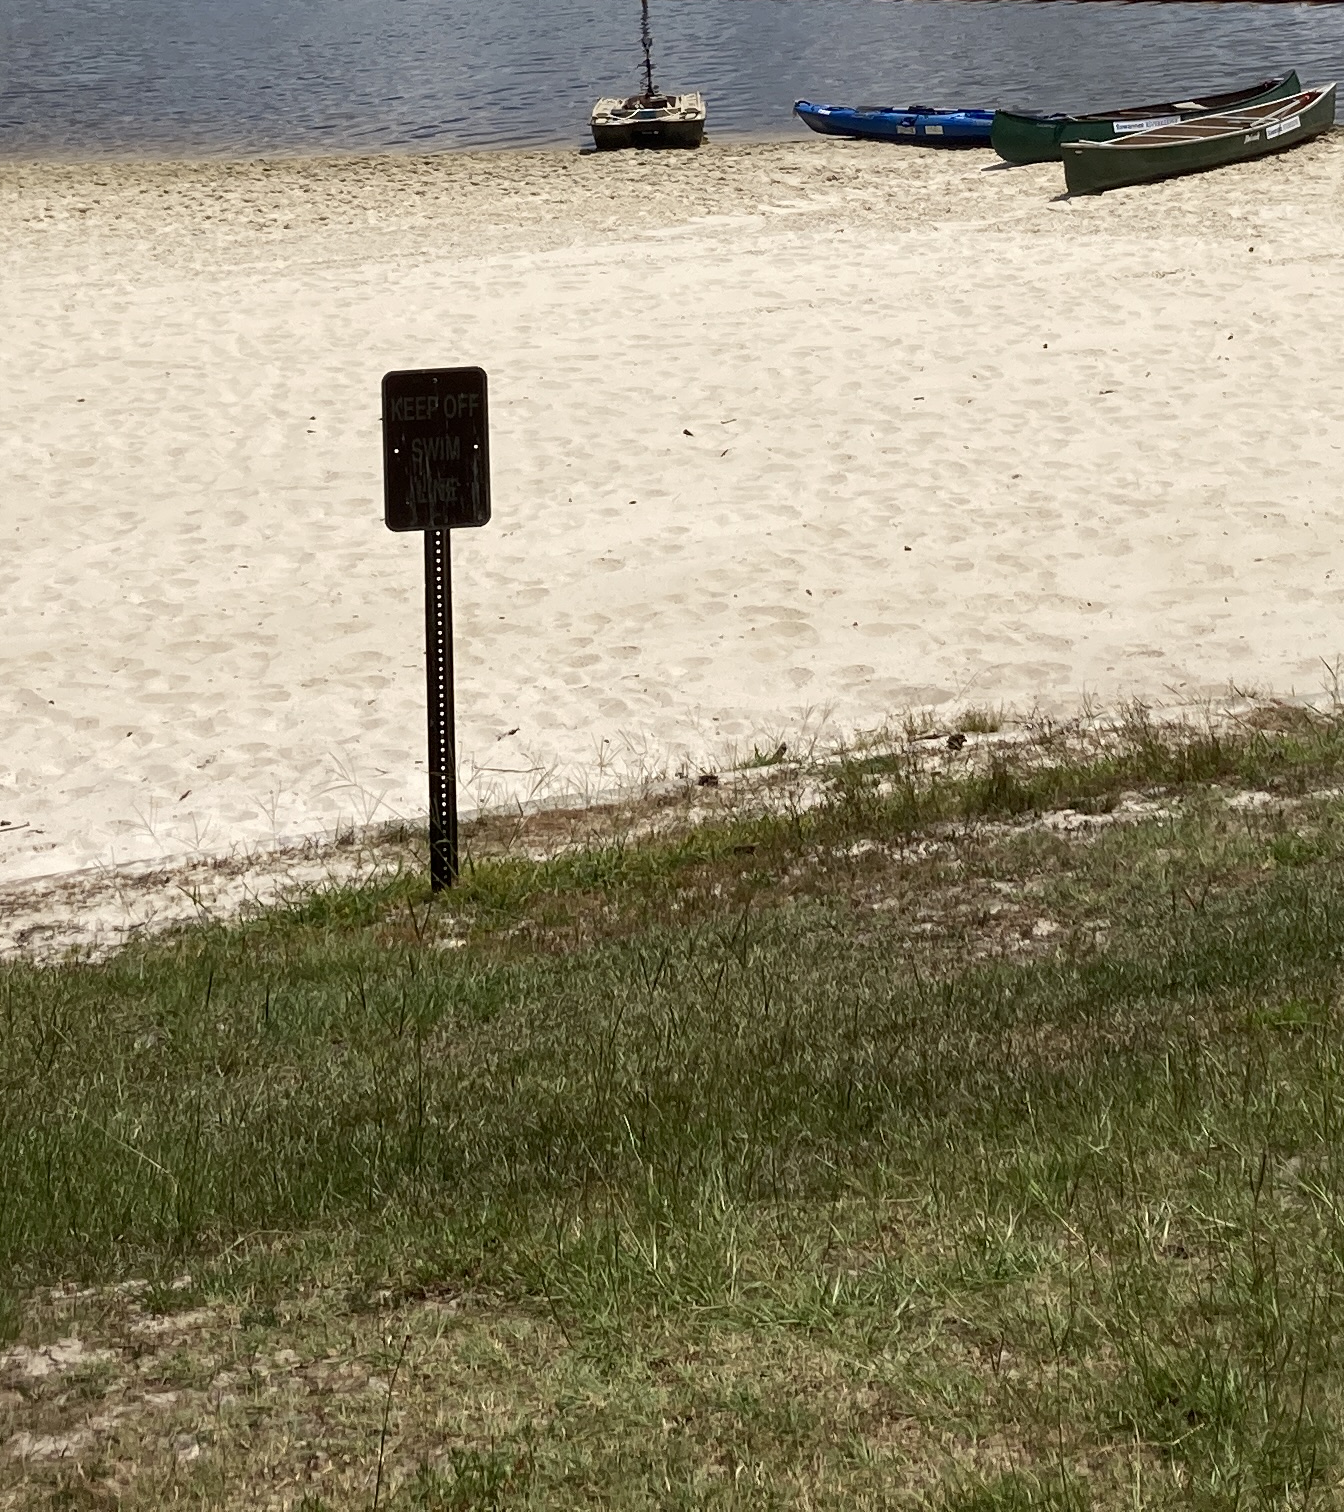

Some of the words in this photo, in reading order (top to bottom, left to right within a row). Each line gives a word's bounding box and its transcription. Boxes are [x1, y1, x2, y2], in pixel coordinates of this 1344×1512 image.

[391, 396, 438, 422] KEEP
[444, 393, 479, 419] OFF
[412, 436, 461, 462] SWIM
